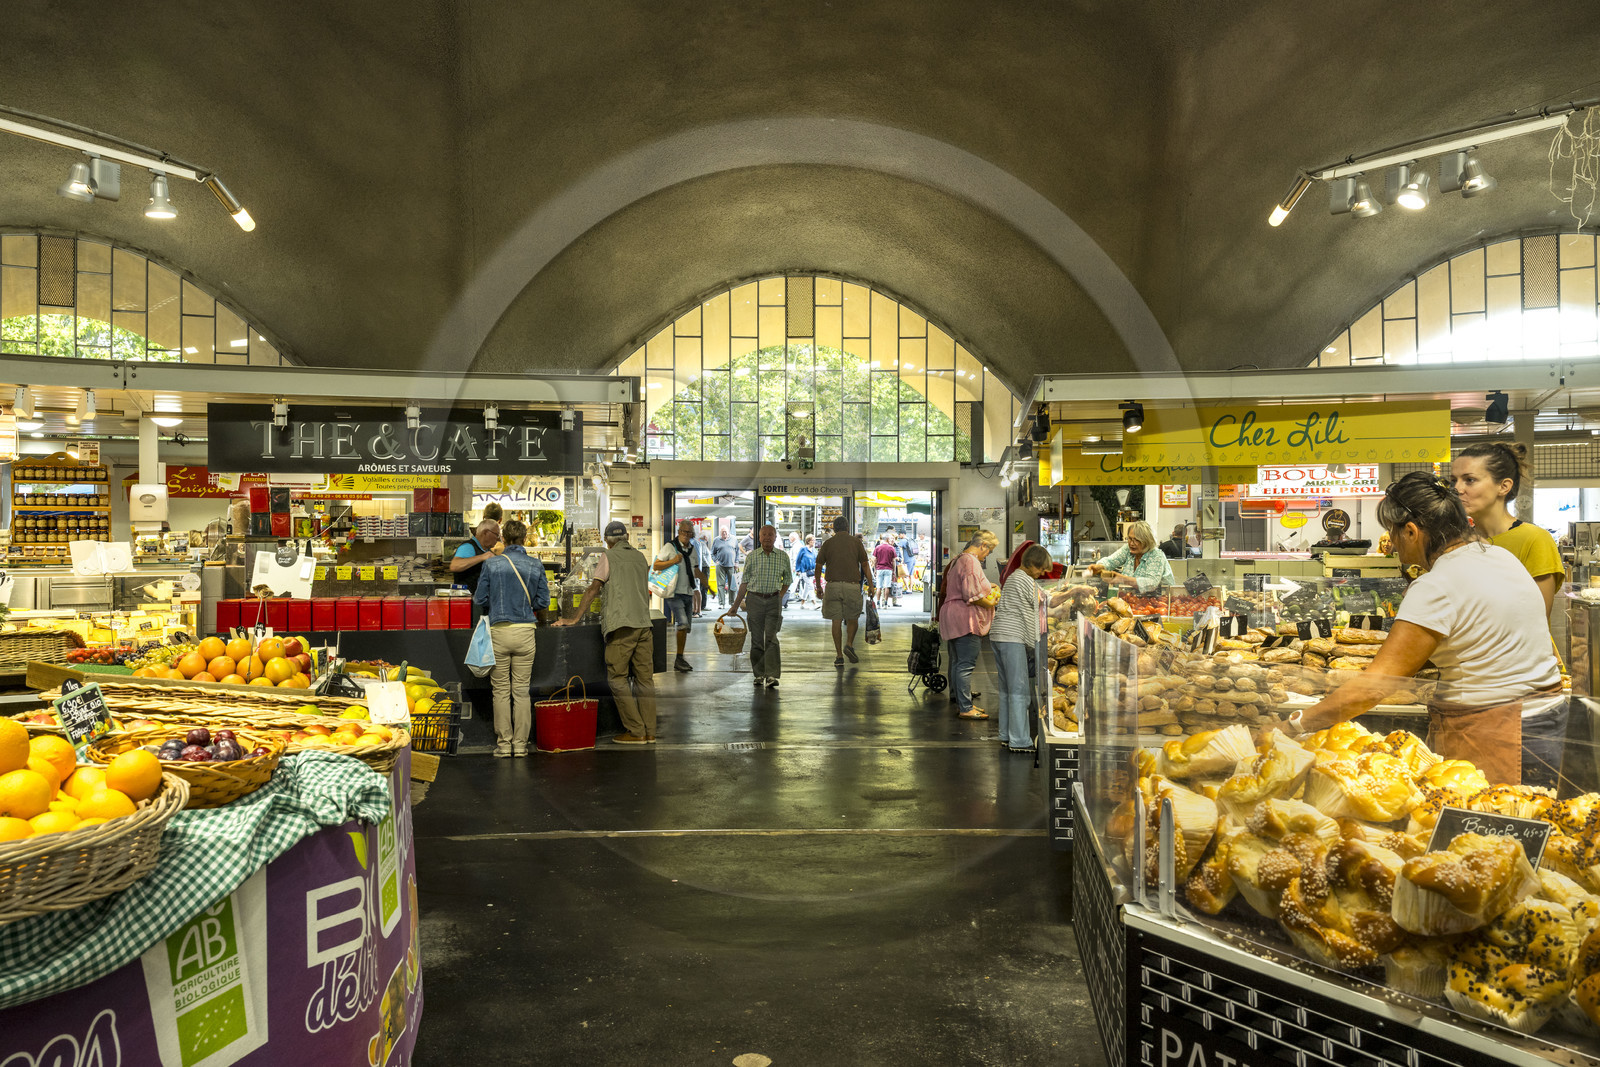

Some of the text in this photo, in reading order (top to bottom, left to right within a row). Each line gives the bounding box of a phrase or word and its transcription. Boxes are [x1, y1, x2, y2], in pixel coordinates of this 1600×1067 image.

[367, 422, 407, 461] &
[1209, 410, 1350, 451] Chez Lili
[358, 462, 451, 473] ARÔMES ET SAVEURS
[763, 485, 848, 494] SORTIE Font de Cherves
[1263, 486, 1332, 495] ELEVEUR
[1461, 816, 1520, 837] Brioche
[176, 917, 227, 981] AB
[173, 956, 240, 998] AGRICULTURE
[174, 967, 241, 1009] BIOLOGIQUE
